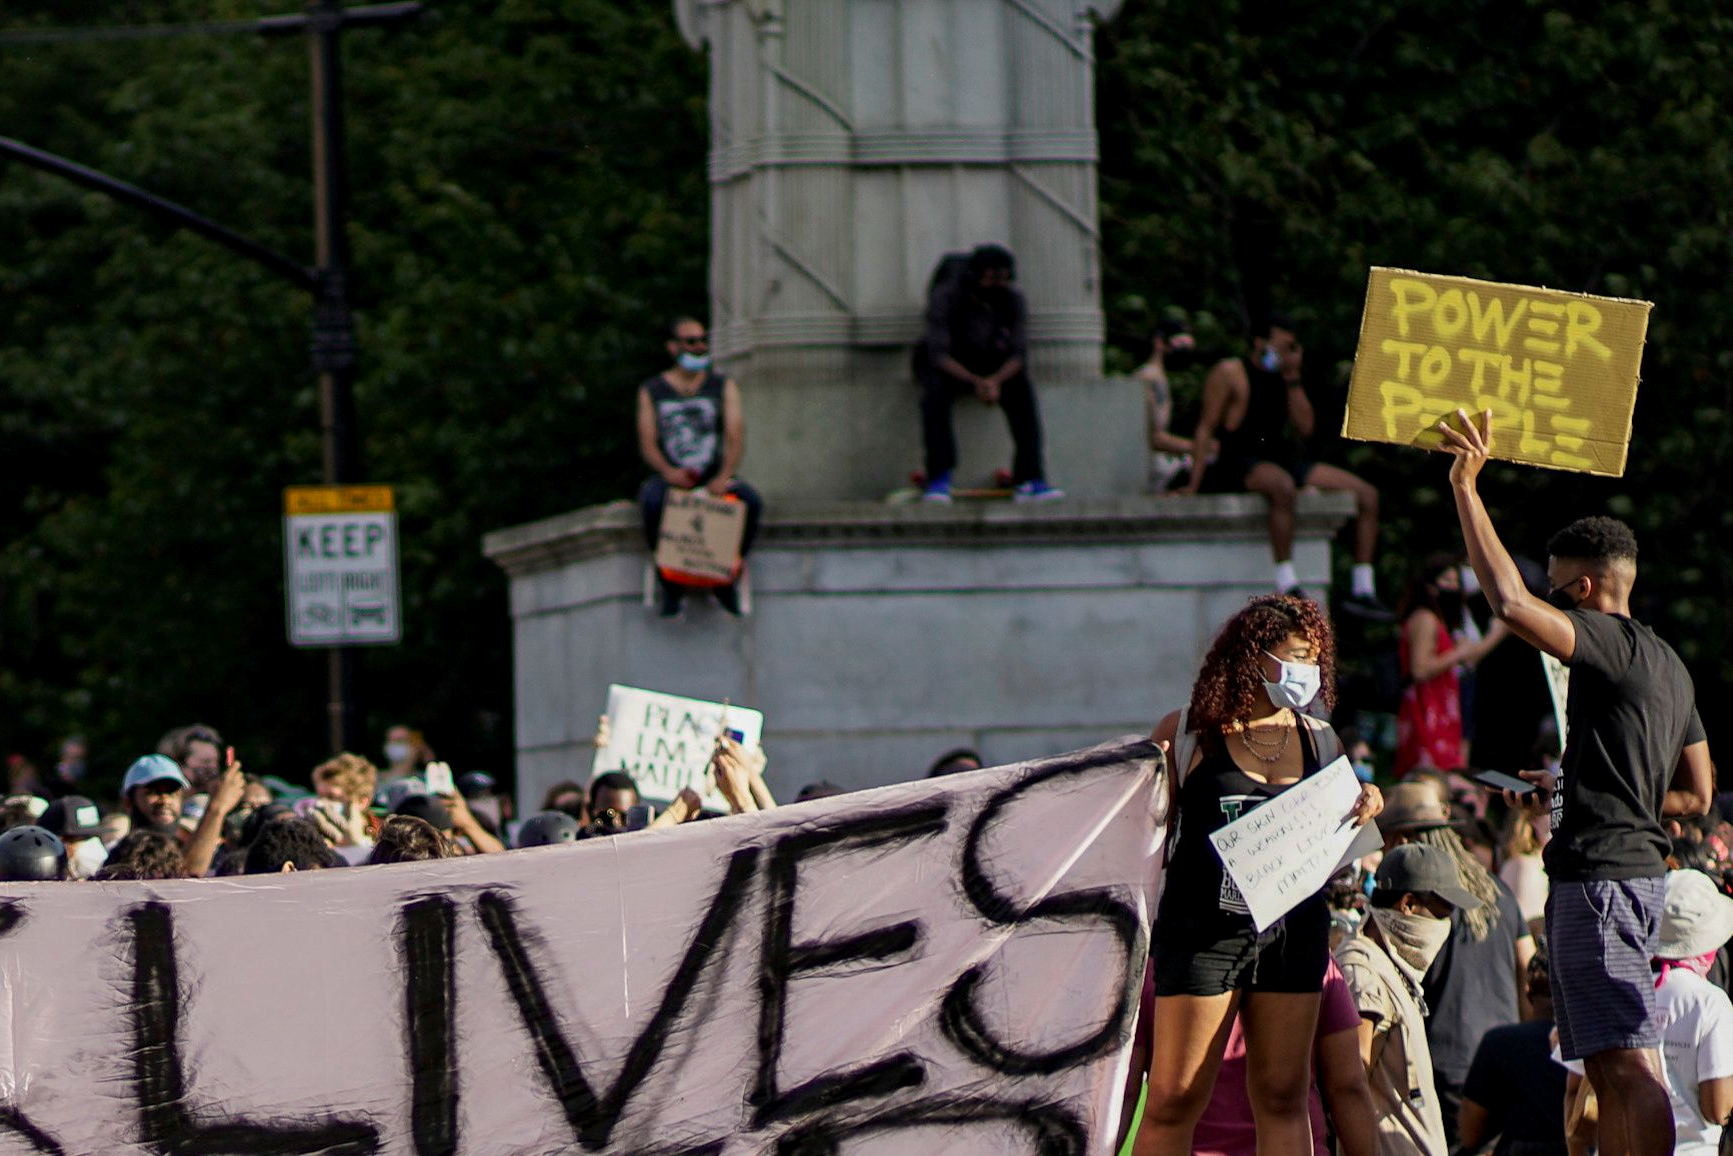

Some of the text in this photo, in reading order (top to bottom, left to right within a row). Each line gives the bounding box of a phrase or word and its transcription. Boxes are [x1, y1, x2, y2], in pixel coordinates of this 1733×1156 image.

[1389, 277, 1613, 362] POWER
[1380, 337, 1571, 409] TO THE
[297, 522, 384, 560] KEEP
